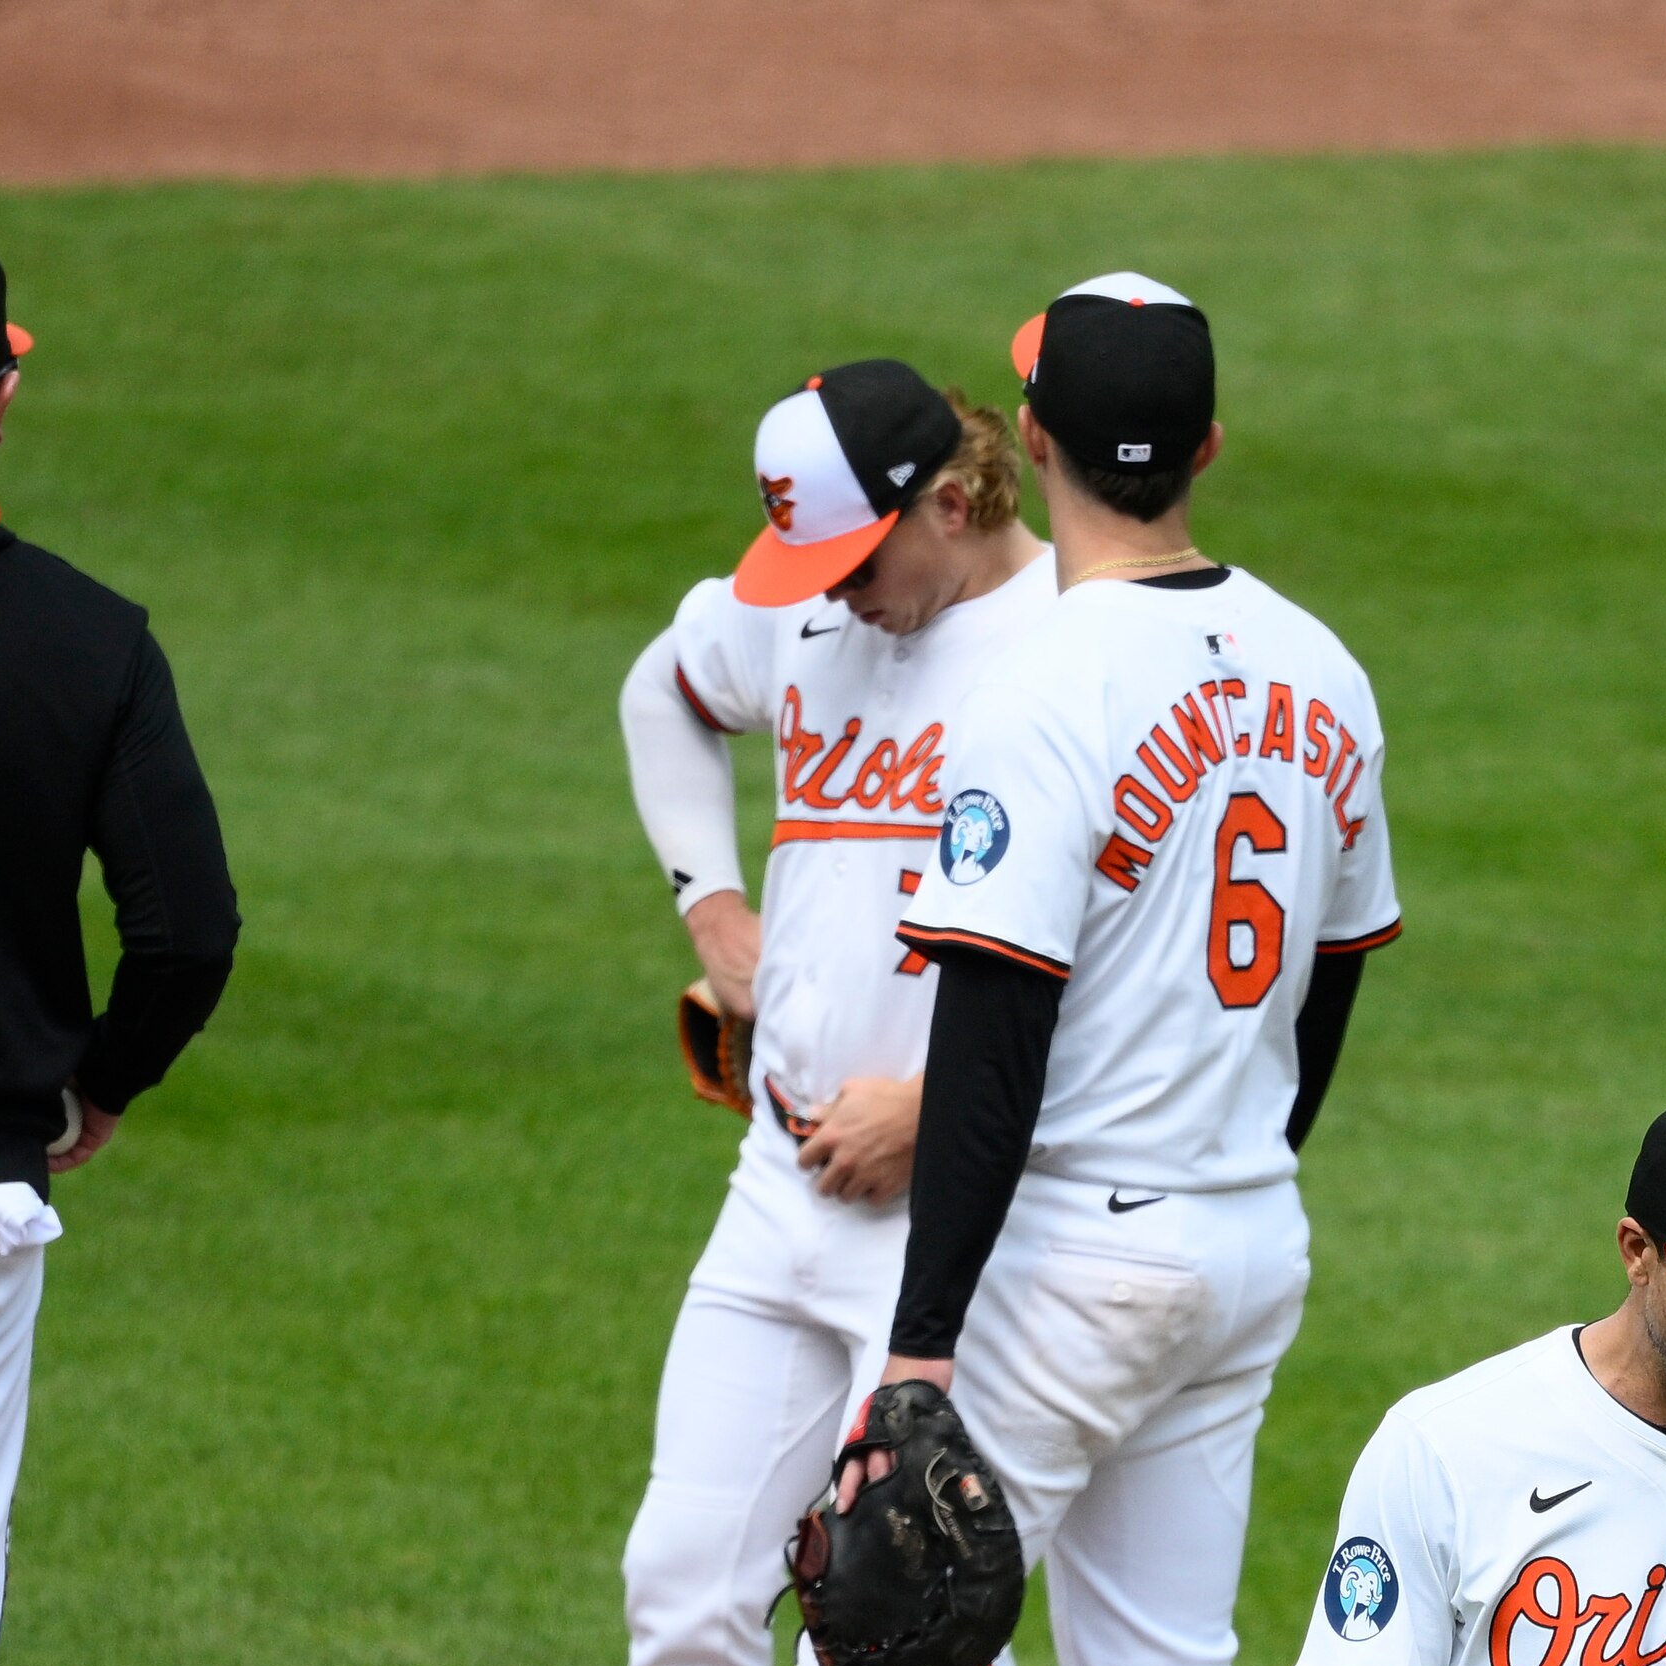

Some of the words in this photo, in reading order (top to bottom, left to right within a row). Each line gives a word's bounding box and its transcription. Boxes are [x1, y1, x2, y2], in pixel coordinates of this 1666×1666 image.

[780, 684, 945, 814] riole
[1206, 792, 1287, 1011] 6
[1332, 1560, 1346, 1576] T.
[1340, 1544, 1371, 1564] Rowe
[1370, 1544, 1392, 1583] Price
